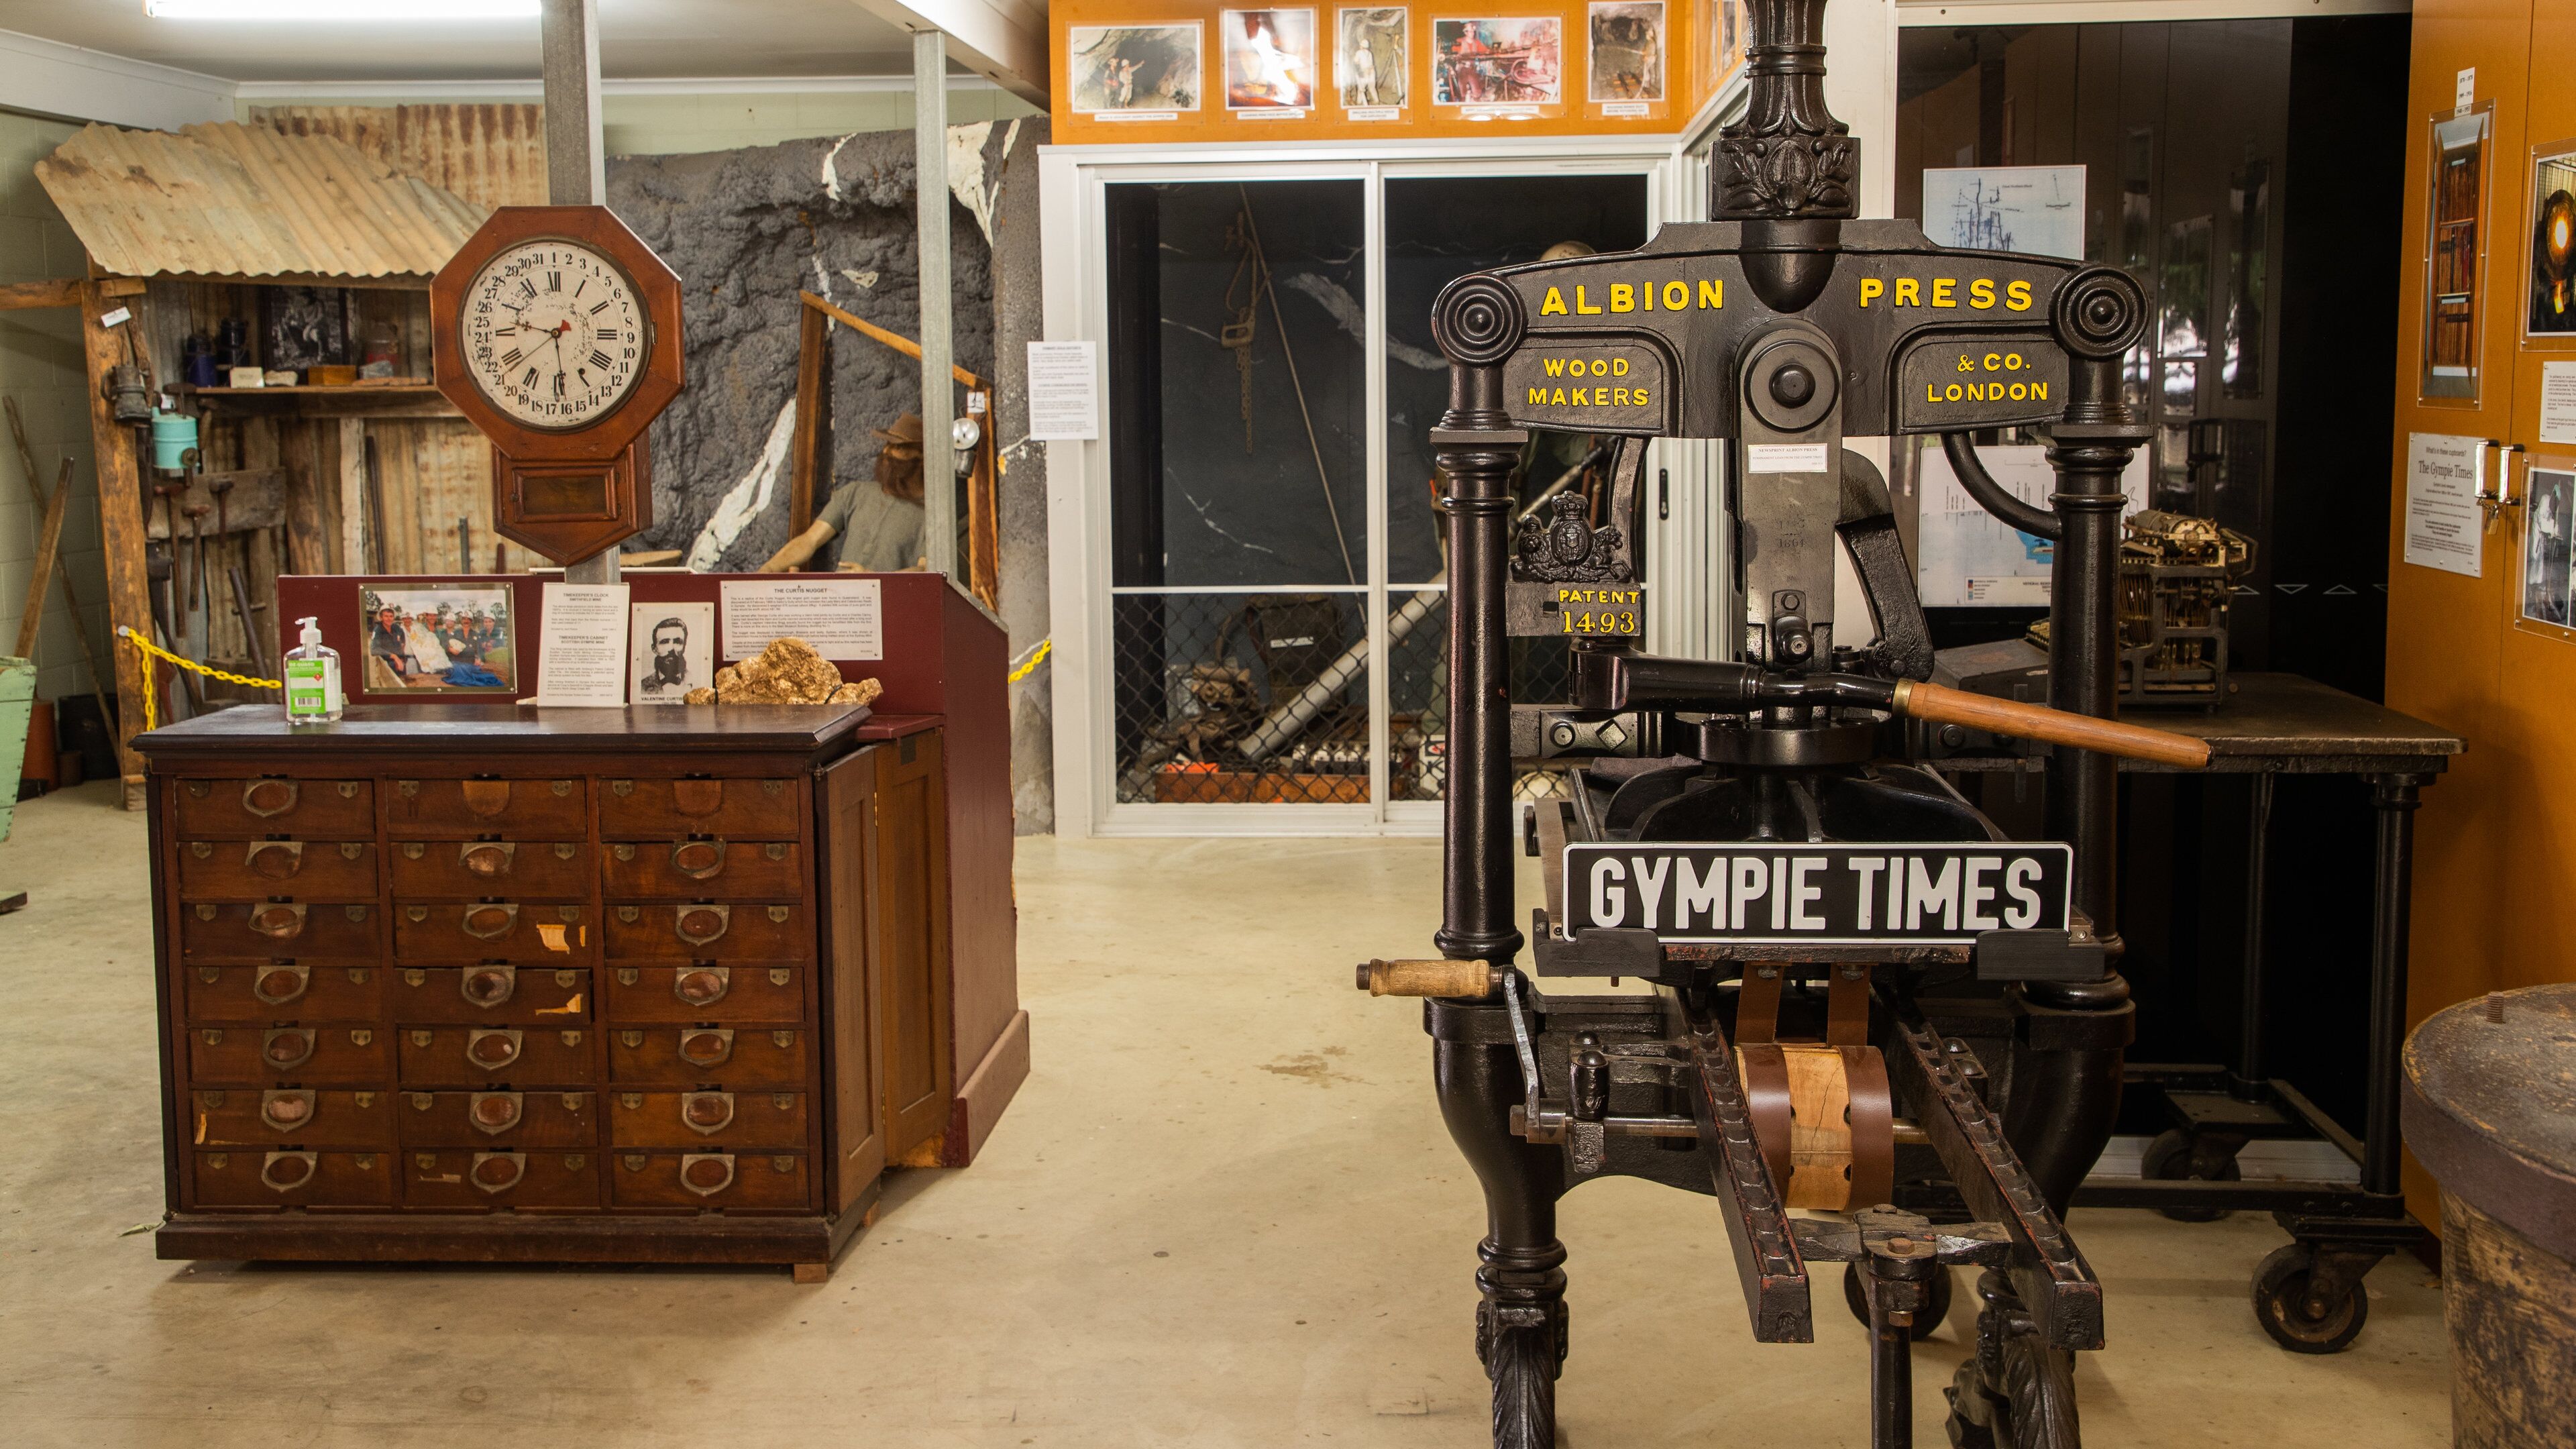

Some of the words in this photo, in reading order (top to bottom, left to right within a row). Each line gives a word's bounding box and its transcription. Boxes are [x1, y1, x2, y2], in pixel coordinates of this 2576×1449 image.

[518, 258, 531, 269] 30
[533, 253, 544, 265] 31
[553, 252, 557, 263] 1
[566, 254, 573, 264] 2
[580, 258, 586, 270] 3
[504, 265, 519, 277] 29
[592, 266, 600, 277] 4
[492, 275, 506, 287] 28
[604, 276, 612, 287] 5
[484, 288, 498, 299] 27
[613, 288, 621, 299] 6
[1541, 278, 1723, 315] ALBION
[1860, 276, 2032, 311] PRESS
[478, 301, 492, 313] 26
[590, 300, 609, 315] II
[621, 301, 629, 313] 7
[475, 315, 490, 328] 25
[625, 316, 633, 328] 8
[475, 331, 491, 343] 24
[596, 329, 617, 340] III
[627, 332, 635, 343] 9
[478, 346, 492, 358] 23
[624, 347, 635, 359] 10
[588, 349, 612, 371] IIII
[1957, 355, 1975, 372] &
[1983, 353, 2031, 372] CO.
[484, 361, 498, 373] 22
[620, 362, 629, 373] 11
[1543, 356, 1629, 377] WOOD
[493, 374, 504, 386] 21
[611, 375, 622, 386] 12
[504, 385, 518, 396] 20
[601, 386, 612, 397] 13
[1528, 386, 1648, 407] MAKERS
[1927, 382, 2047, 402] LONDON
[519, 394, 529, 405] 19
[589, 394, 599, 406] 14
[532, 400, 543, 412] 18
[546, 403, 557, 415] 17
[561, 403, 572, 415] 16
[576, 400, 586, 412] 15
[2418, 460, 2430, 474] The
[2430, 462, 2453, 480] Gympie
[2454, 464, 2473, 479] Times
[1559, 589, 1640, 604] PATENT
[1563, 611, 1635, 633] 1493
[1590, 857, 1828, 930] GYMPIE
[1848, 857, 2042, 930] TIMES
